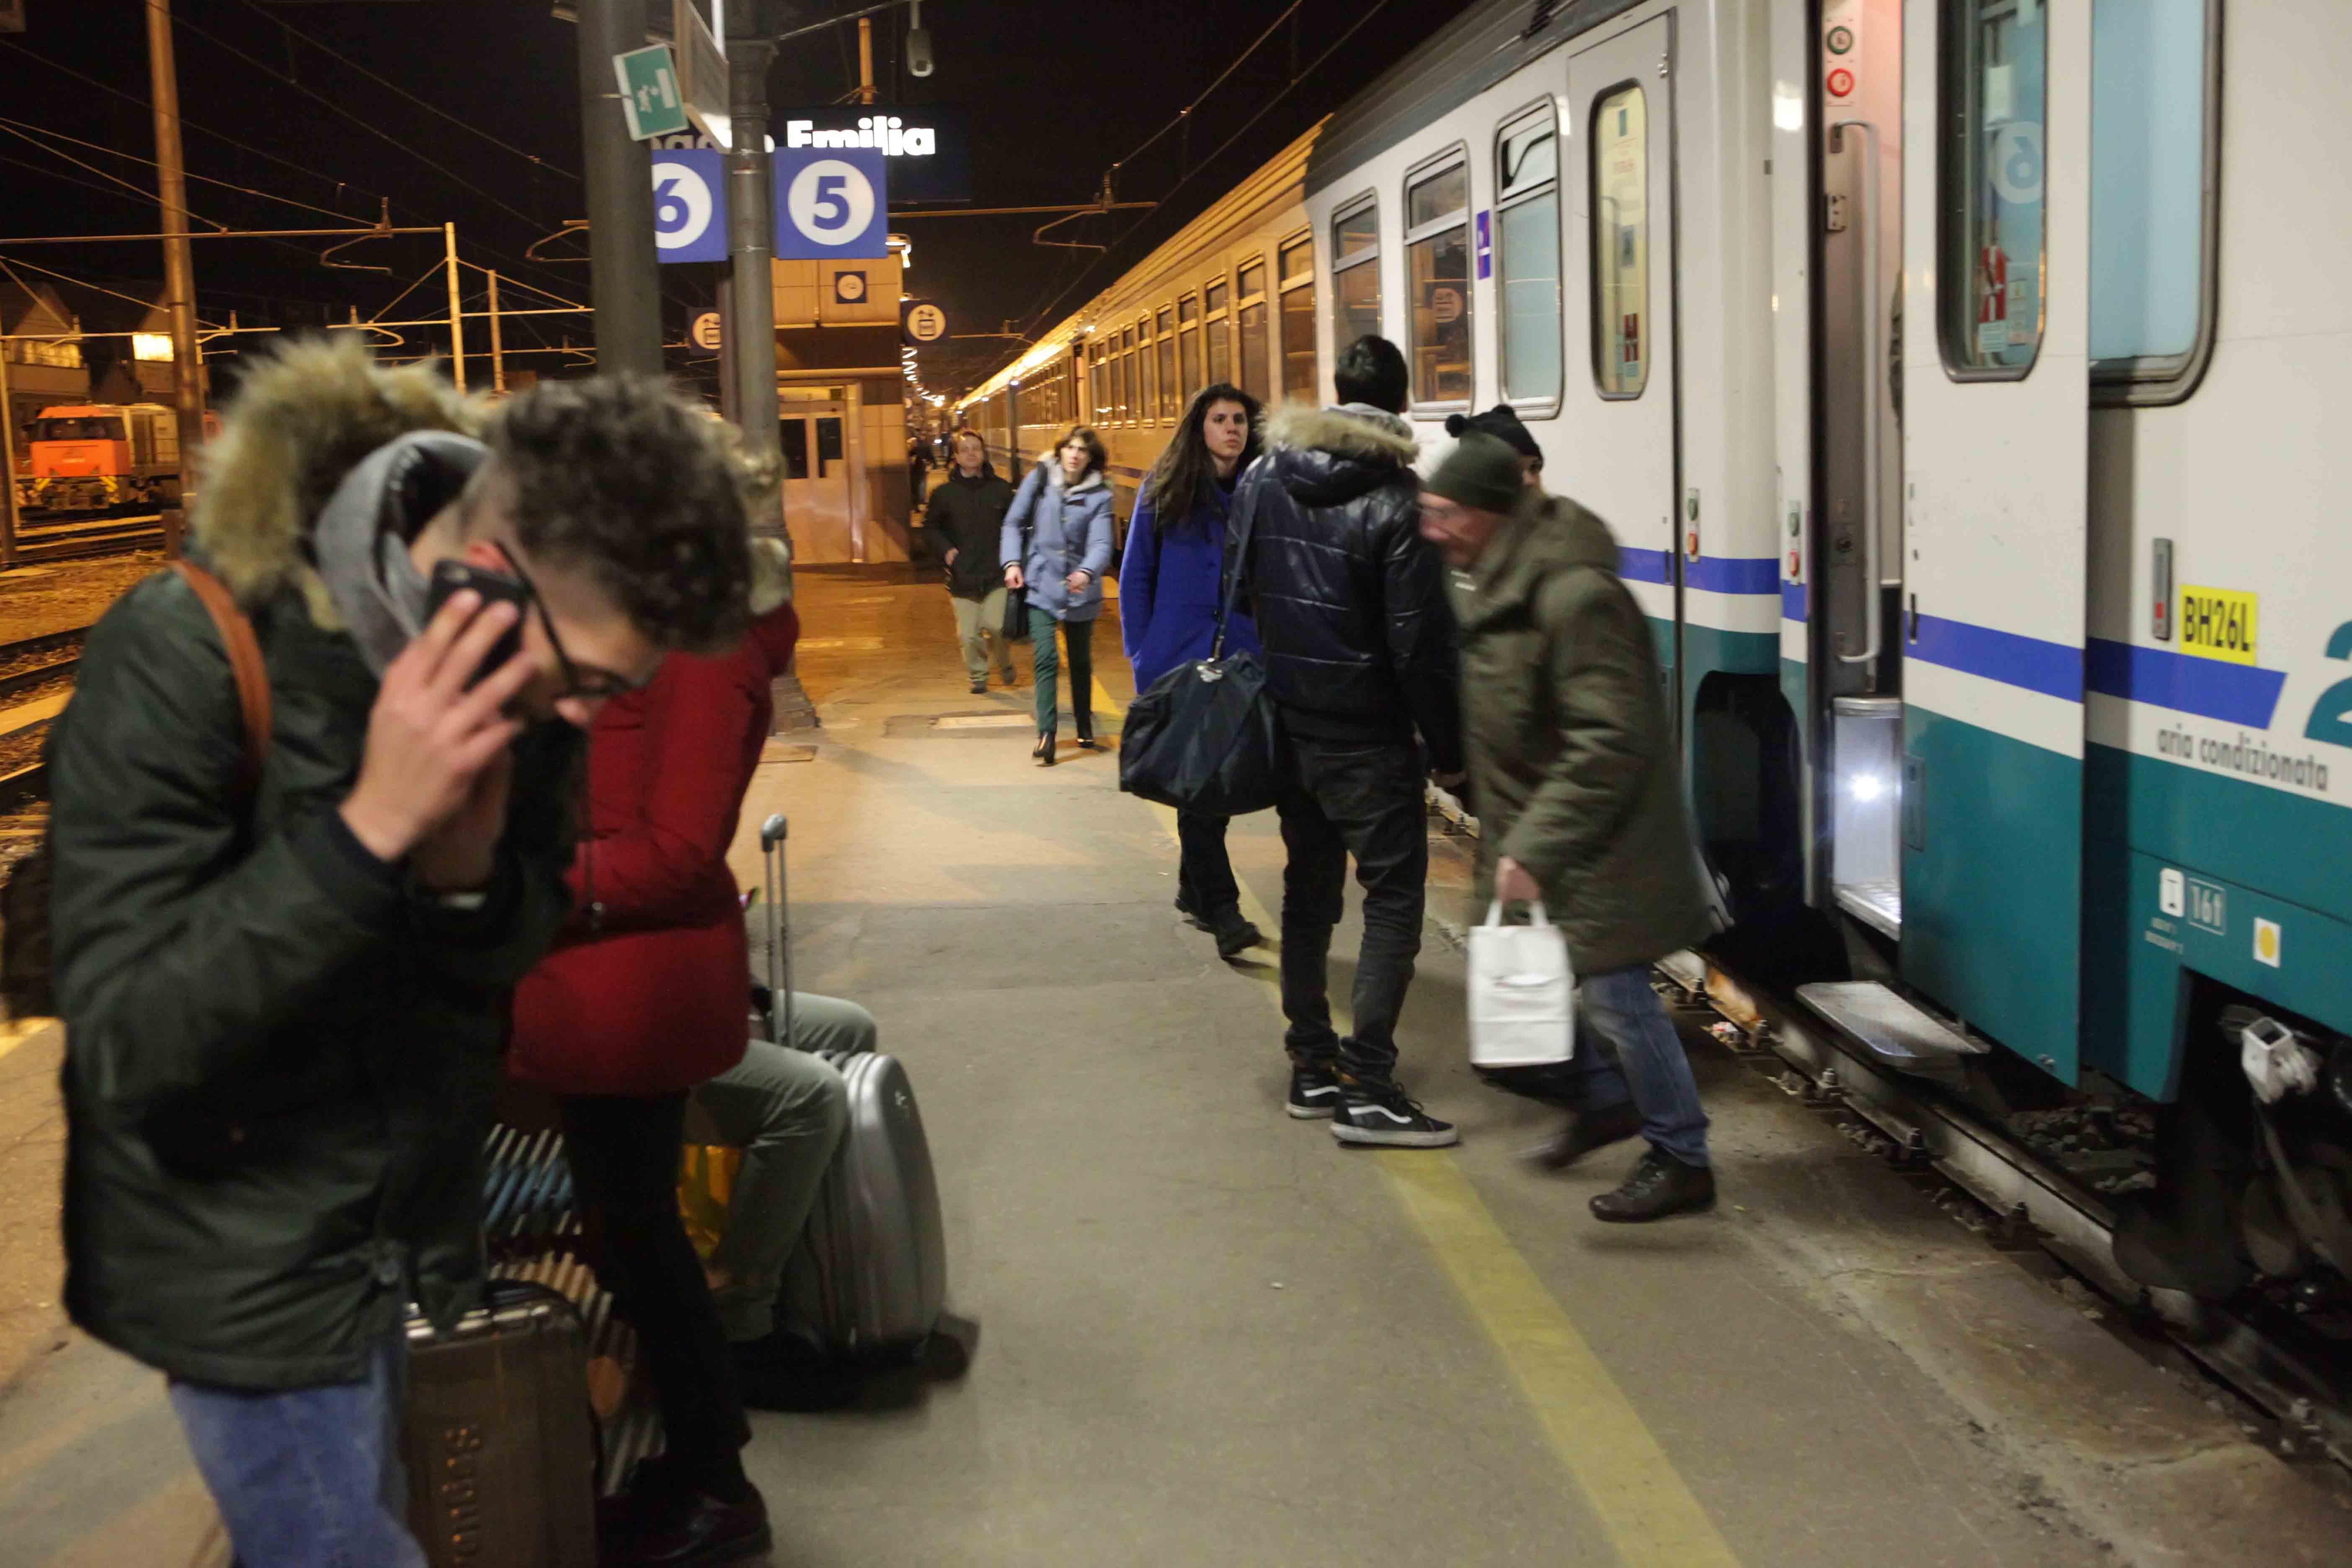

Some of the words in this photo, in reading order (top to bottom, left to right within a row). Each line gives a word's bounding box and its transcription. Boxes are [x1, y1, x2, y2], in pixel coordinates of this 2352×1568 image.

[652, 178, 689, 233] 6
[814, 176, 849, 230] 5
[2158, 722, 2193, 759] aria
[2200, 731, 2328, 792] condizionata
